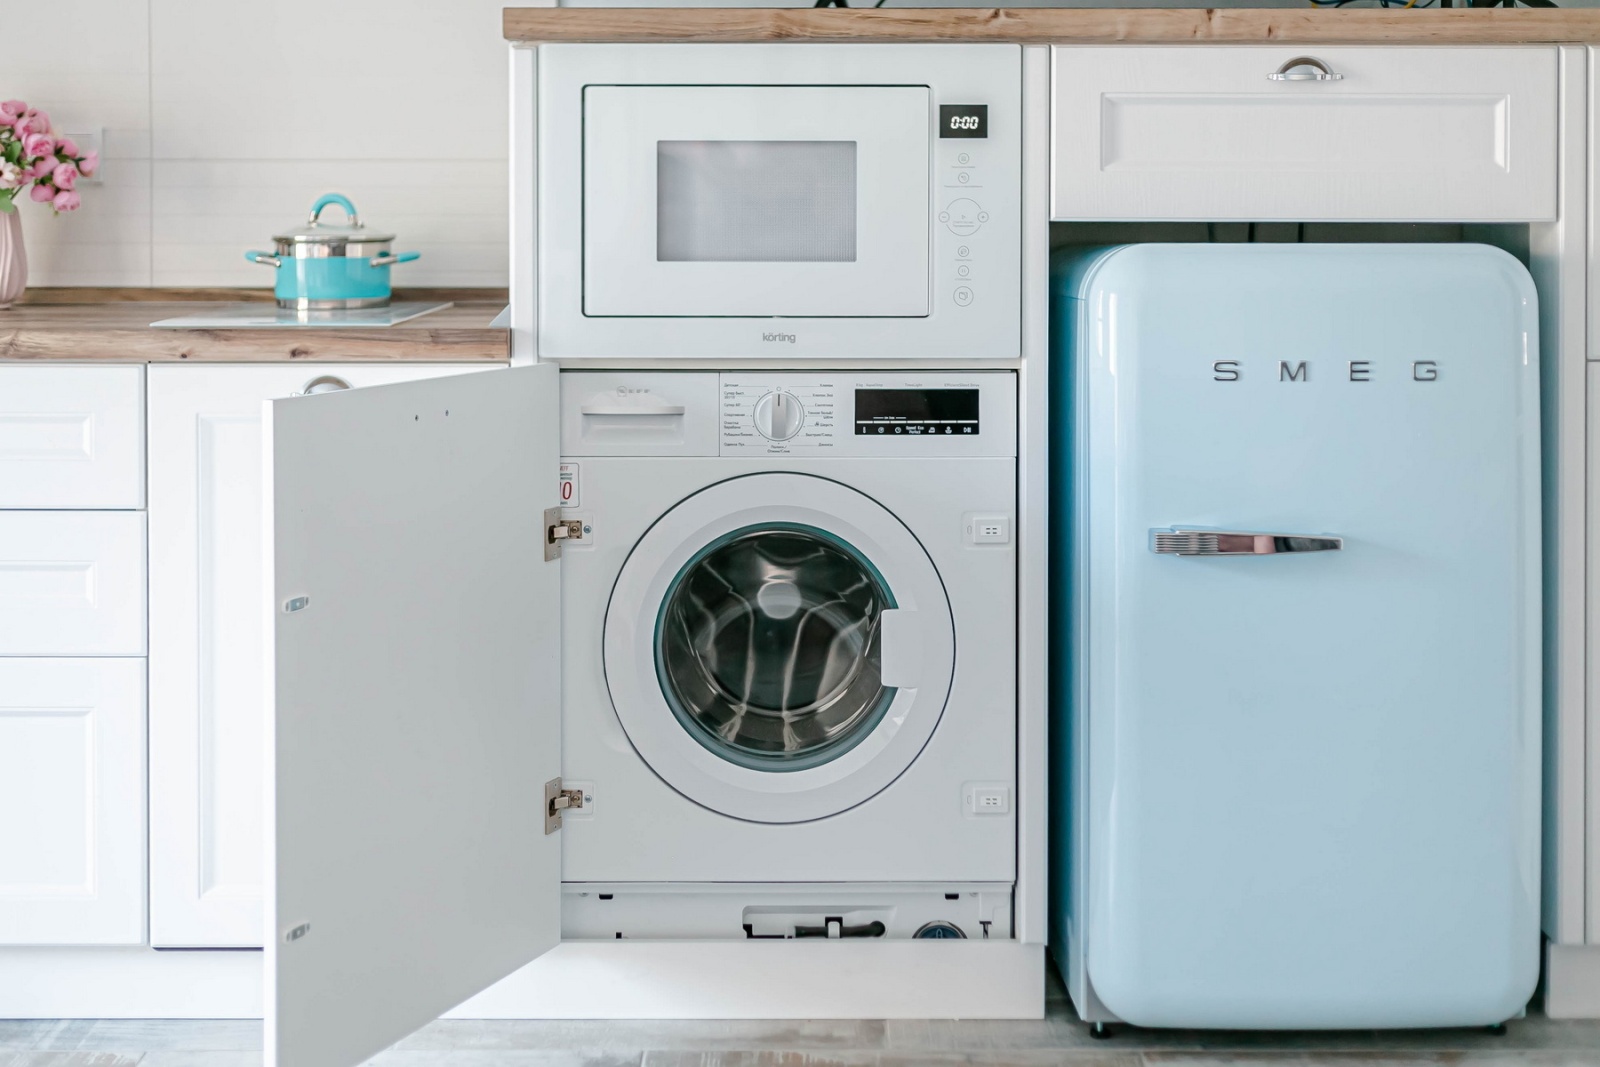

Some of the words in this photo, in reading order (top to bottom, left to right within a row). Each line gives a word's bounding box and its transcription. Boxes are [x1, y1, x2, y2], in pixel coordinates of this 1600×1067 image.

[950, 116, 979, 129] 0:00
[762, 332, 796, 343] körting
[1212, 360, 1438, 382] SMEG
